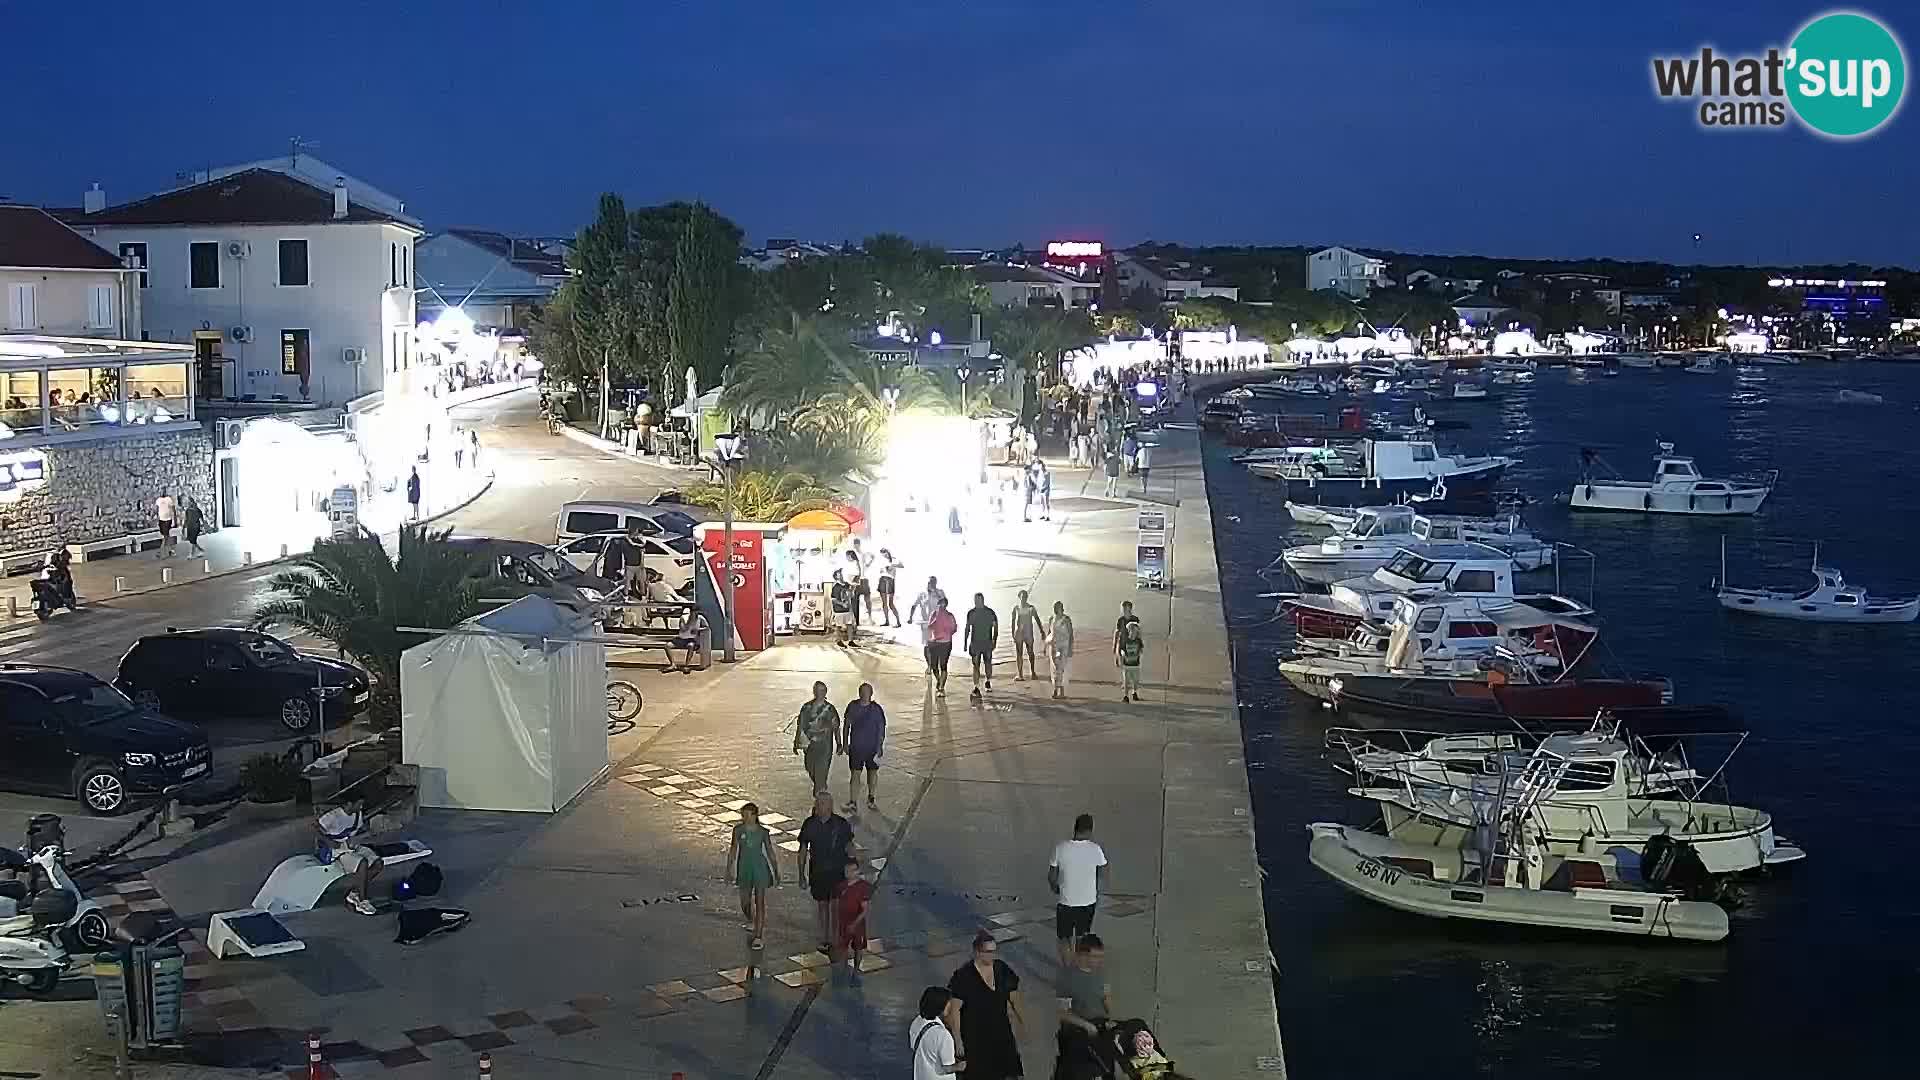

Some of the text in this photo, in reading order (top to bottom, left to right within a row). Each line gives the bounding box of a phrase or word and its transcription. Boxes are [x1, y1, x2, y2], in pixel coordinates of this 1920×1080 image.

[716, 561, 757, 570] BAKOMAT
[1355, 860, 1401, 886] 456 NV
